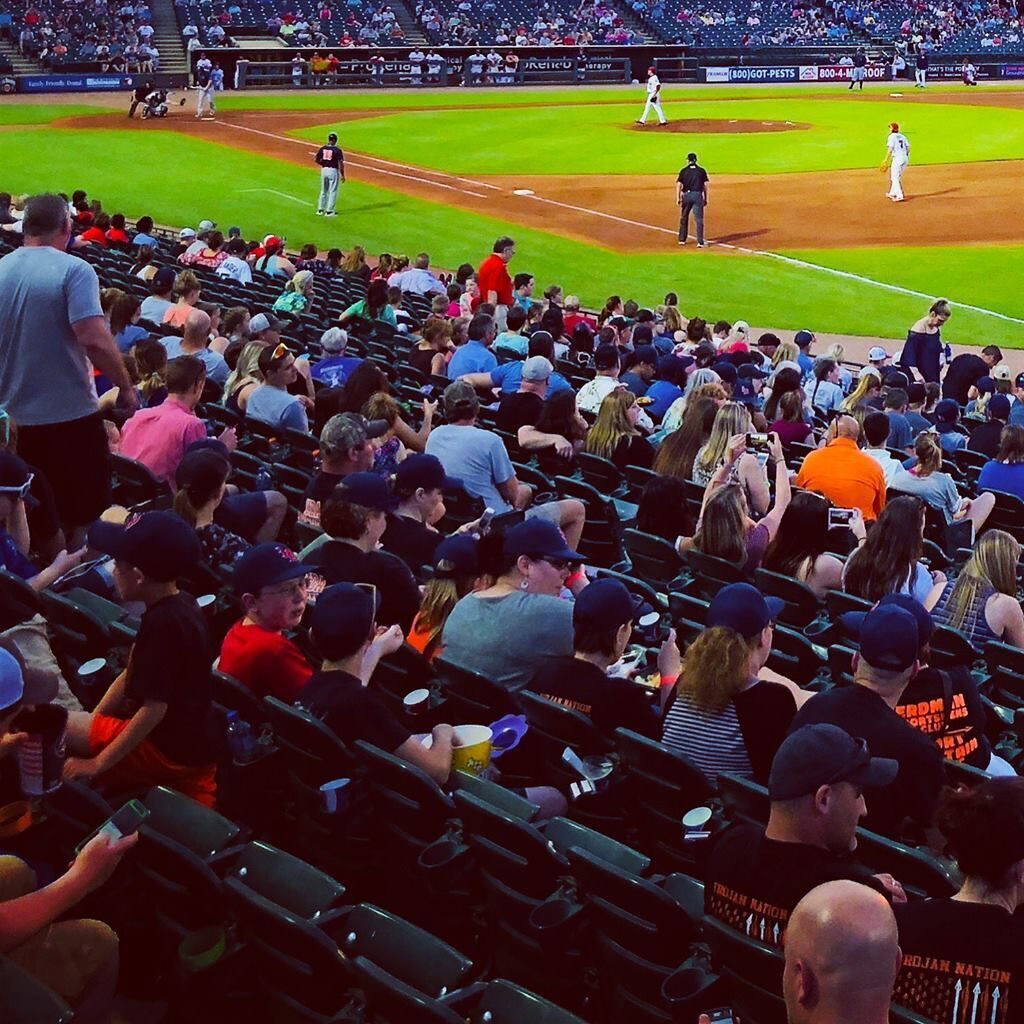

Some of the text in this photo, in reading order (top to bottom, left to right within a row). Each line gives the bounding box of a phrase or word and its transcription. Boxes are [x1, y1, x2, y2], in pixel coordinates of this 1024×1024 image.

[713, 881, 788, 920] TROJAN NATION
[903, 953, 1012, 984] ROJAN NATION
